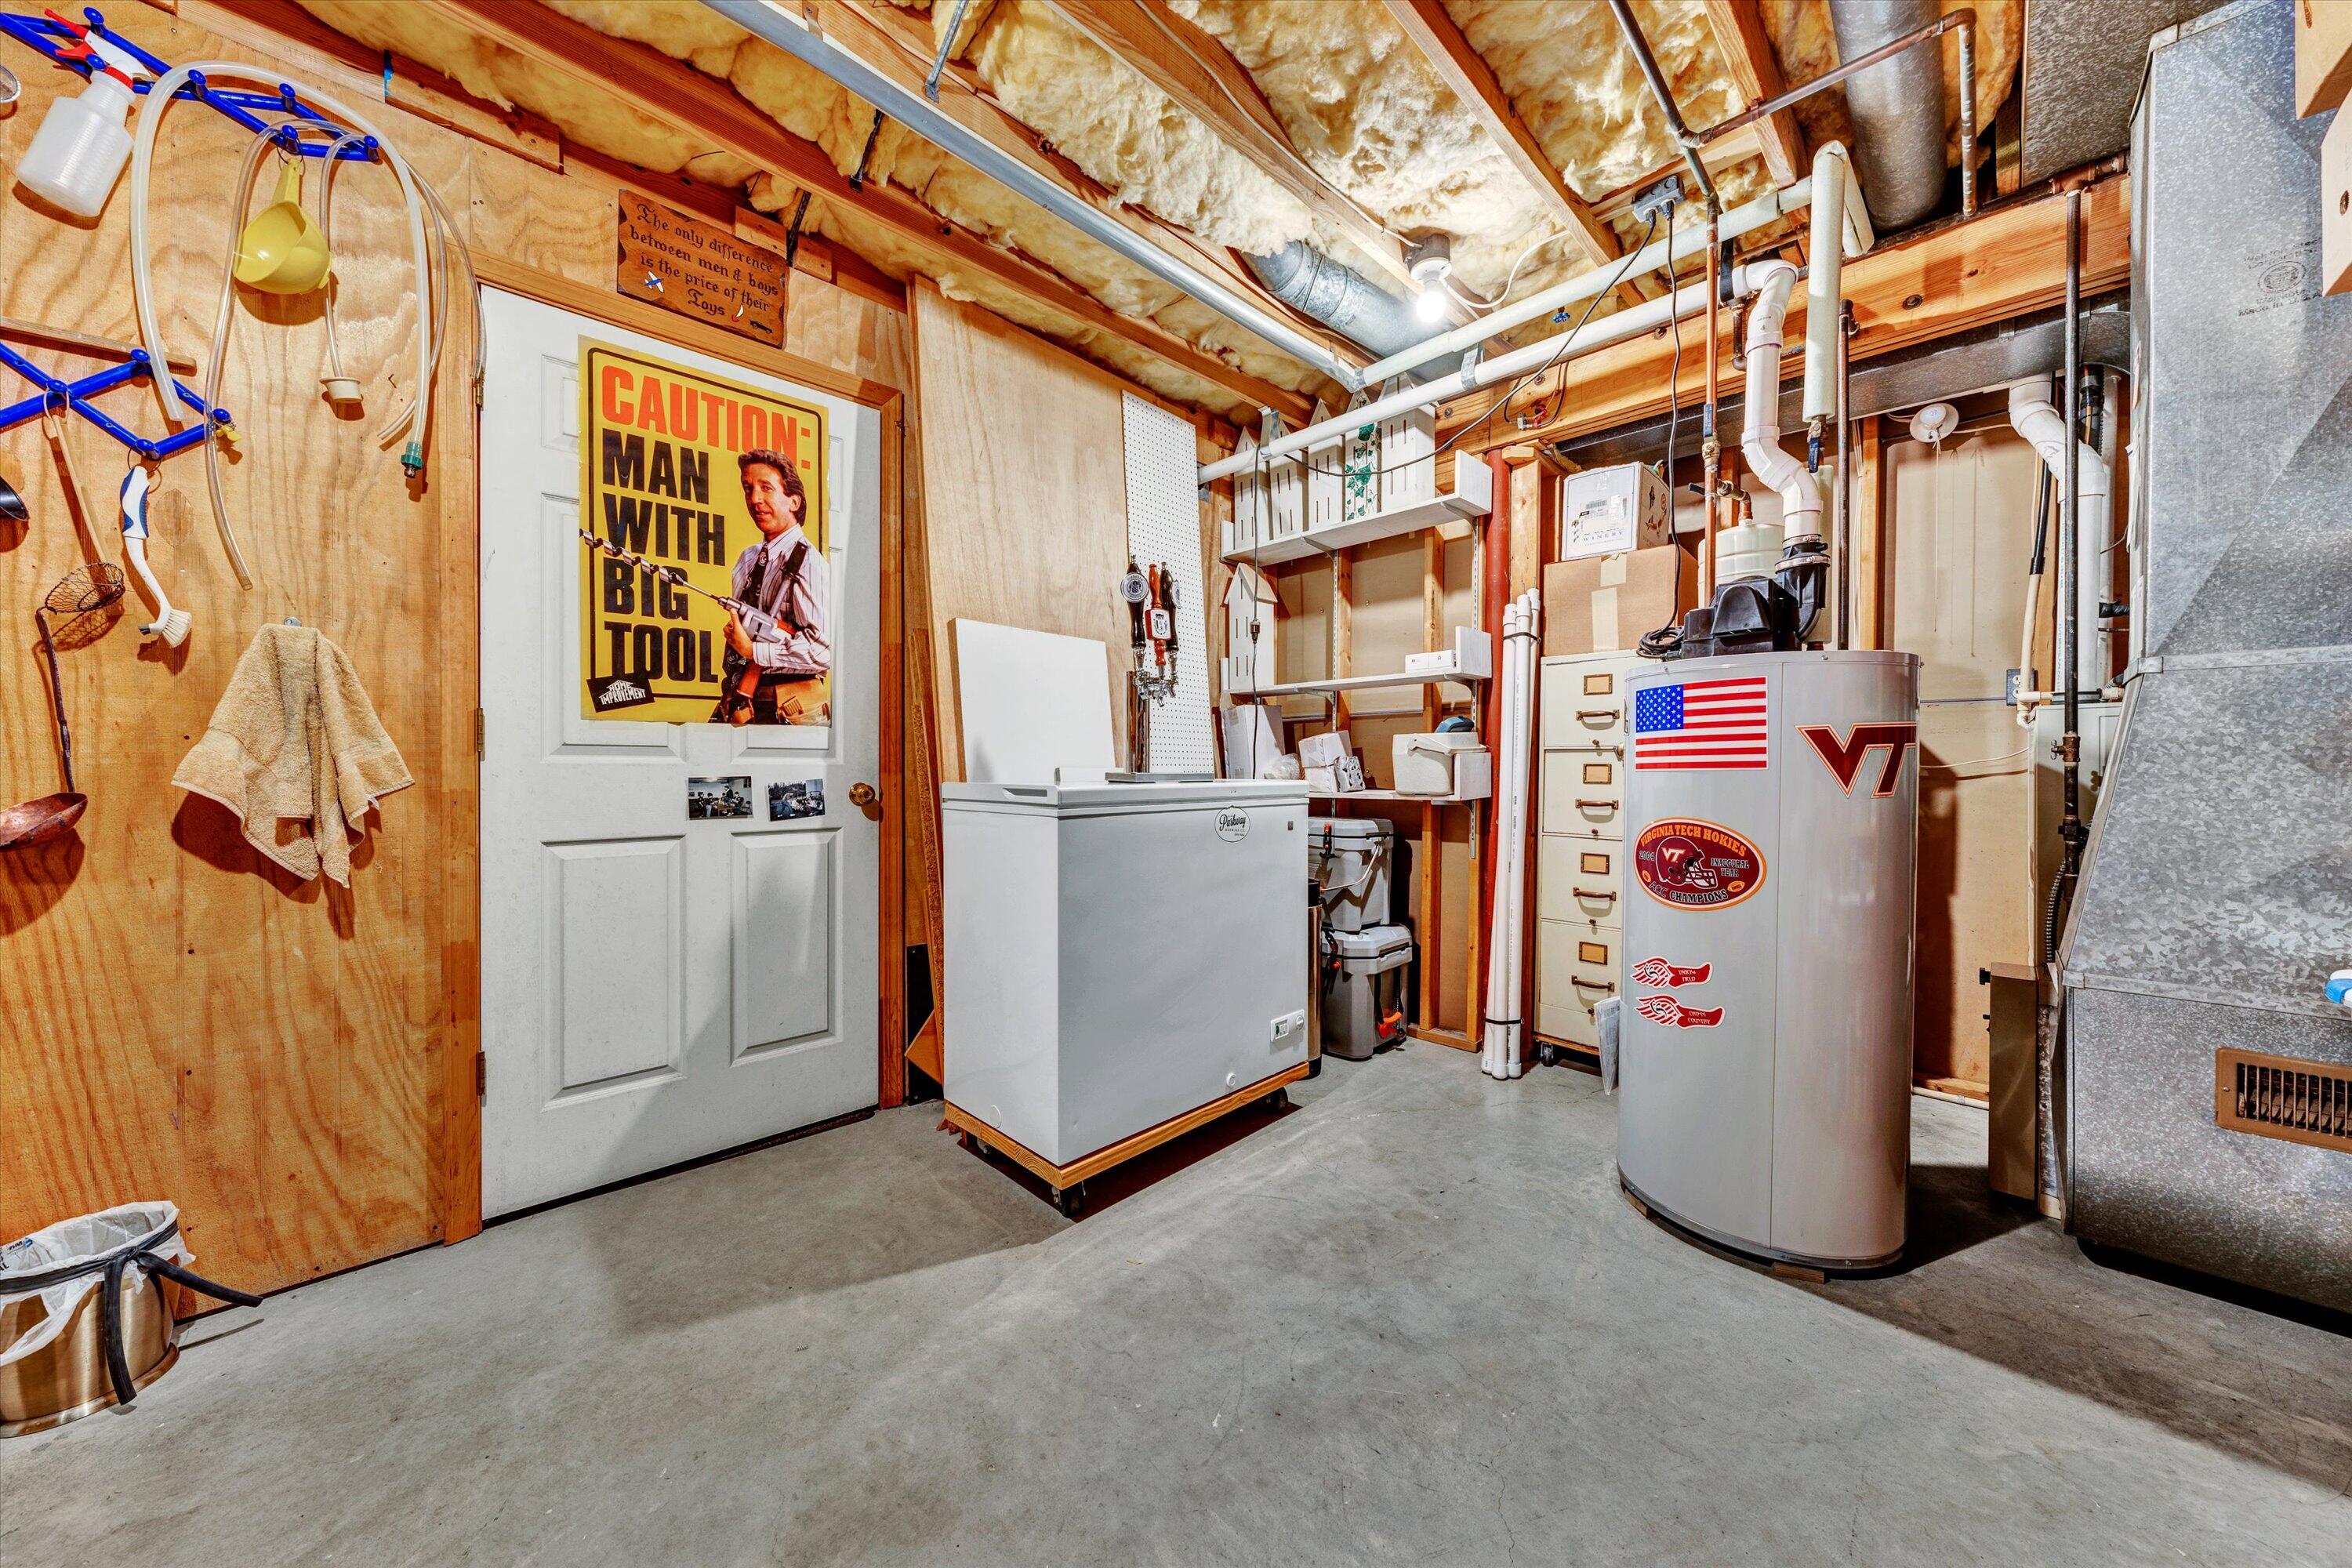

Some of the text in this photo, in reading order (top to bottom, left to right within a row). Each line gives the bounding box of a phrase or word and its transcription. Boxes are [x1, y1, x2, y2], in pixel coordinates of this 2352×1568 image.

[630, 223, 779, 296] between men & boys
[637, 203, 773, 273] The only difference
[641, 251, 771, 312] is the price of their
[687, 288, 726, 316] Toys
[601, 365, 811, 470] CAUTION:
[601, 428, 710, 506] MAN
[602, 492, 726, 567] WITH
[604, 557, 689, 622] BIG
[604, 622, 719, 684] TOOL
[598, 687, 647, 706] IMPROVEMENT
[606, 679, 636, 692] HOME
[1795, 721, 1917, 798] VT
[1639, 847, 1686, 862] 2004 VT
[1640, 825, 1747, 857] VIRGINIA TECH HOKIES
[1711, 858, 1750, 869] INAUGURAL
[1649, 881, 1729, 904] ACC CHAMPIONS
[1720, 868, 1739, 877] YEAR
